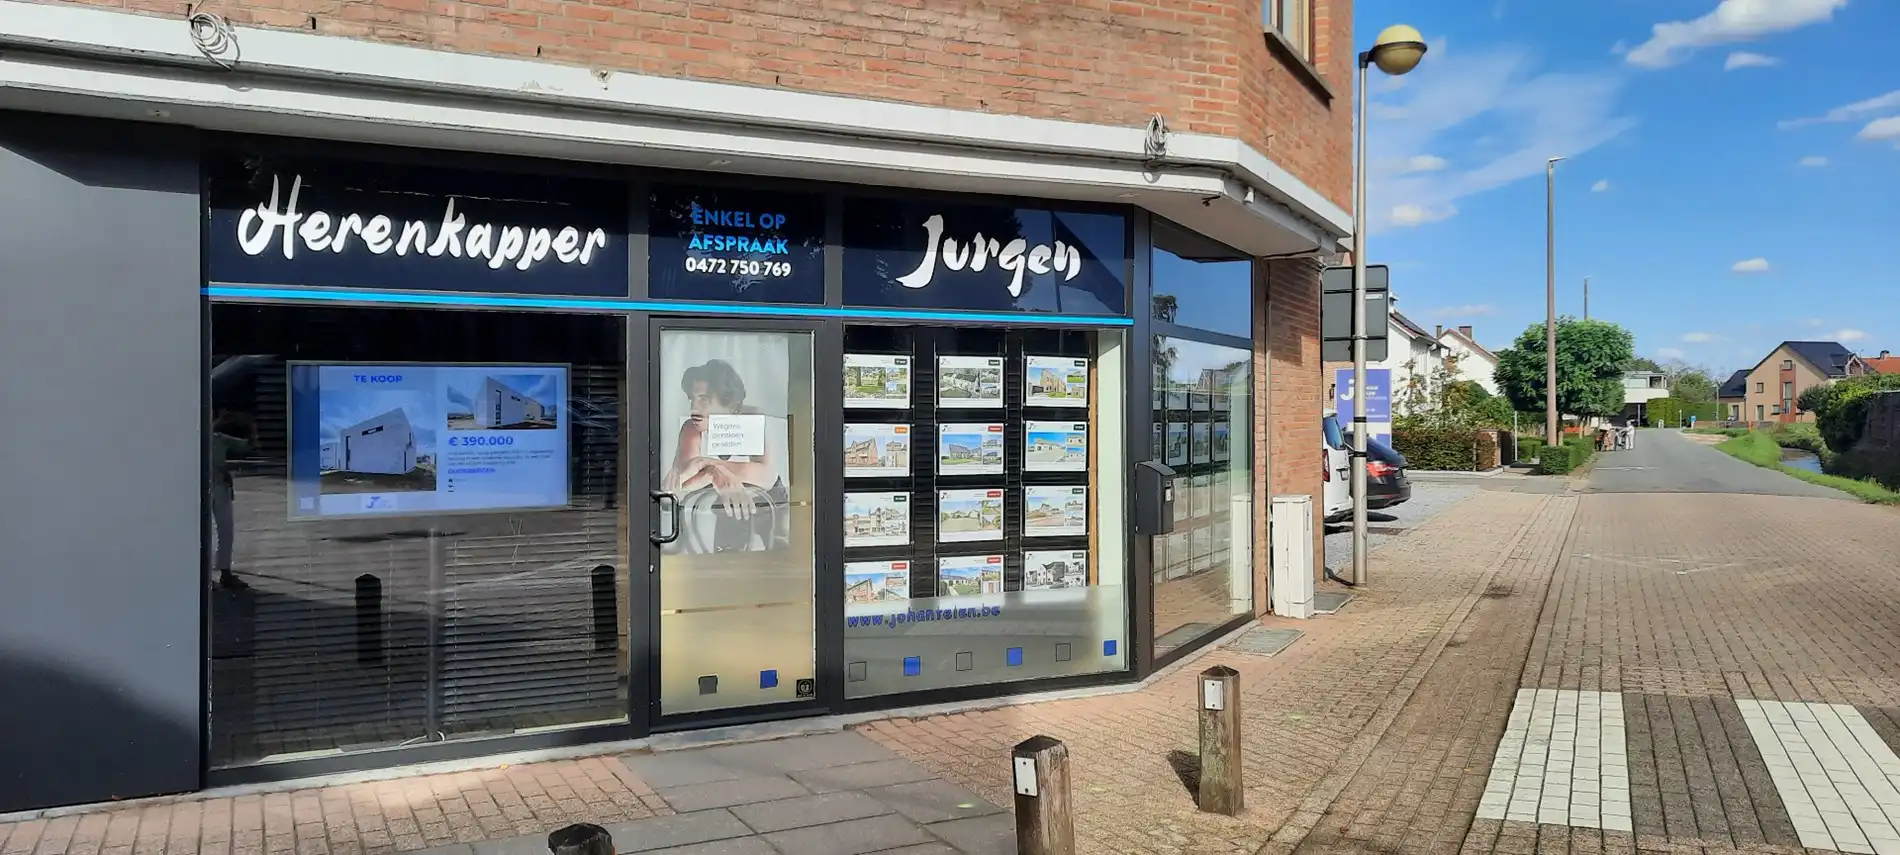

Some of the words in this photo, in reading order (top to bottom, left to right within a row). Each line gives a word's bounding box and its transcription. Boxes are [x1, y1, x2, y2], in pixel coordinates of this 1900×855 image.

[237, 174, 605, 270] Herenkapper
[692, 208, 755, 228] ENKEL
[759, 213, 786, 230] OP
[688, 233, 789, 255] AFSPRAAK
[895, 214, 1081, 297] Jurgen
[685, 257, 727, 274] 0472
[730, 259, 760, 276] 750
[763, 261, 792, 277] 769
[353, 375, 367, 383] TE
[370, 375, 403, 384] KOOP
[461, 436, 514, 446] 390.000
